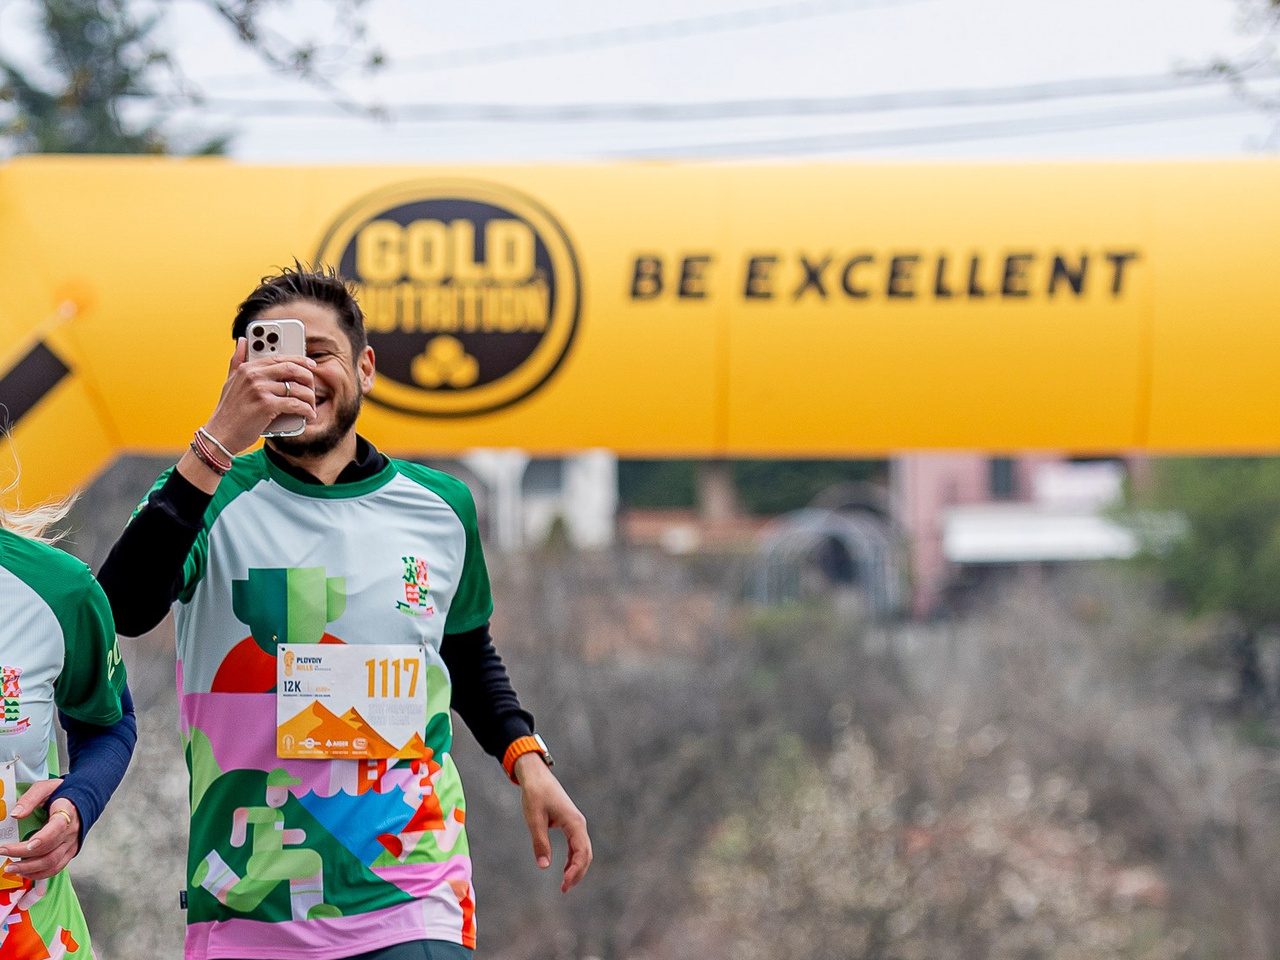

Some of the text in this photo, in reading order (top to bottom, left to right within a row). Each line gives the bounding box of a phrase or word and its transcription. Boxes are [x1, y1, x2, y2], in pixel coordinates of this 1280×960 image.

[356, 218, 536, 282] GOLD
[629, 252, 1140, 300] BE EXCELLENT
[284, 680, 301, 692] 12K
[365, 658, 419, 698] 1117
